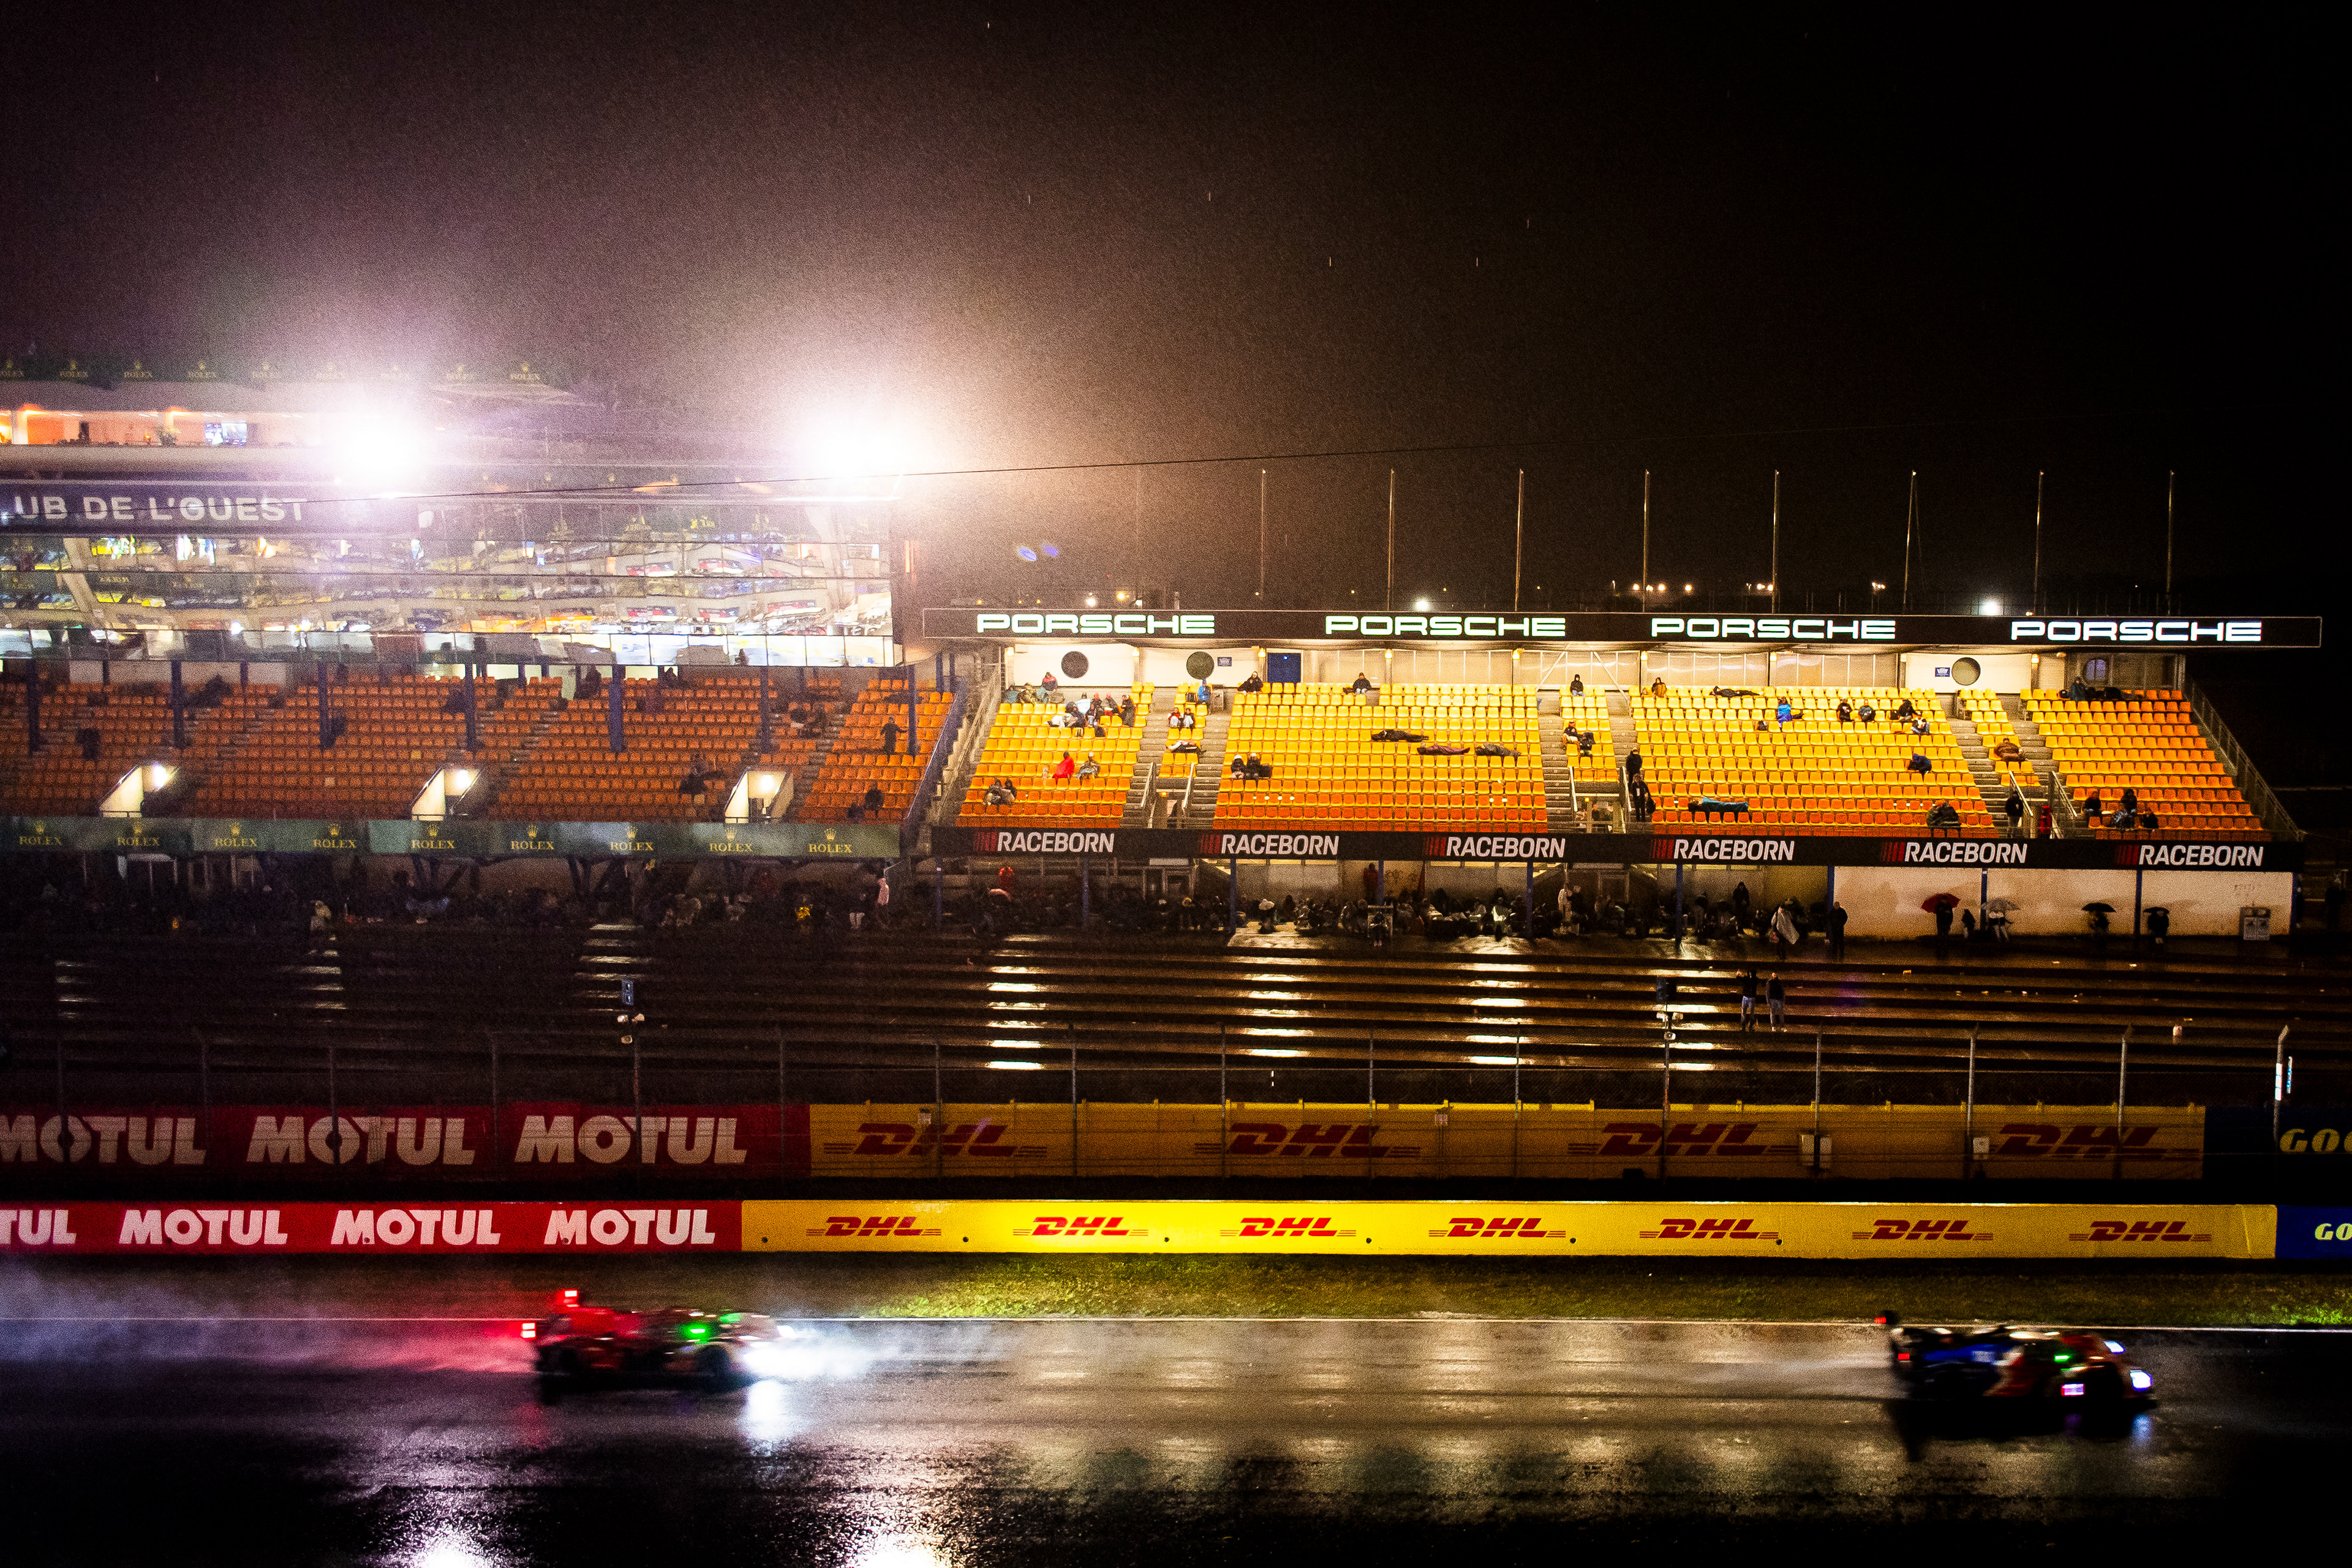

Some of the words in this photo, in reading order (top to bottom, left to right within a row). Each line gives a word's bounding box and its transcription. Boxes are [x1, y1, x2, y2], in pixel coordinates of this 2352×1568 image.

[83, 497, 134, 520] DE
[149, 497, 306, 521] L'OUEST
[977, 614, 1215, 634] PORSCHE
[1325, 616, 1566, 636] PORSCHE
[1652, 618, 1896, 638] PORSCHE
[2011, 621, 2262, 641] PORSCHE
[20, 836, 61, 846] ROLEX
[117, 837, 159, 846] ROLEX
[214, 838, 257, 848] ROLEX
[313, 839, 356, 849] ROLEX
[412, 840, 454, 850] ROLEX
[511, 841, 554, 850] ROLEX
[610, 842, 654, 851] ROLEX
[709, 843, 752, 852] ROLEX
[809, 844, 852, 853] ROLEX
[997, 832, 1114, 853] RACEBORN
[1221, 834, 1339, 855] RACEBORN
[1446, 837, 1566, 858] RACEBORN
[1673, 839, 1795, 860] RACEBORN
[1904, 842, 2027, 862] RACEBORN
[2139, 845, 2263, 866] RACEBORN
[0, 1115, 206, 1164] MOTUL
[247, 1115, 475, 1164] MOTUL
[515, 1115, 747, 1164] MOTUL
[852, 1123, 1017, 1156] DHL
[1226, 1122, 1390, 1158] DHL
[1595, 1122, 1766, 1156] DHL
[1997, 1123, 2168, 1161] DHL
[2280, 1128, 2352, 1153] GO
[119, 1209, 288, 1245] MOTUL
[331, 1209, 500, 1245] MOTUL
[544, 1209, 715, 1245] MOTUL
[824, 1216, 923, 1236] DHL
[1033, 1217, 1129, 1236] DHL
[1239, 1217, 1337, 1237] DHL
[1448, 1218, 1547, 1237] DHL
[1657, 1219, 1760, 1239] DHL
[1872, 1220, 1974, 1240] DHL
[2087, 1221, 2193, 1242] DHL
